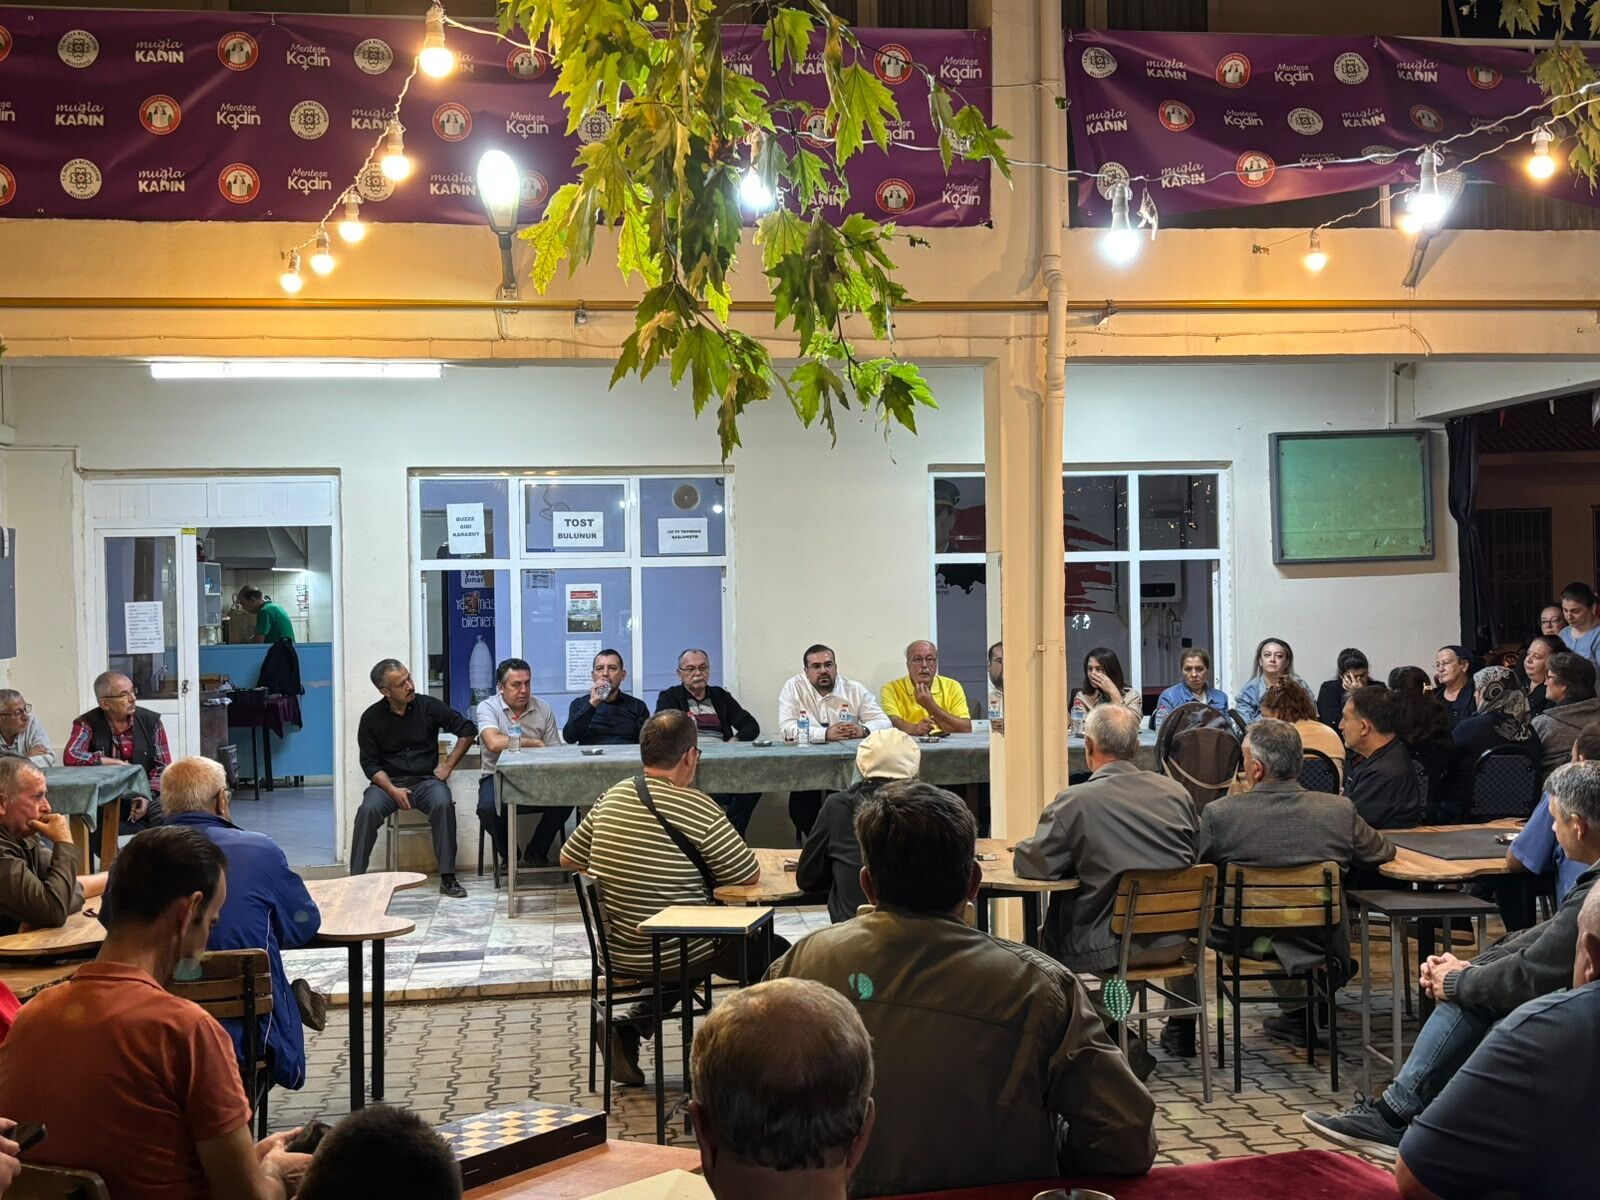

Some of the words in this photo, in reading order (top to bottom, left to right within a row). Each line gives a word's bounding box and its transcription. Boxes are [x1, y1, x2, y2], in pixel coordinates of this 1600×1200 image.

[135, 50, 184, 63] KADIN
[795, 62, 825, 75] KAD
[1146, 68, 1187, 81] KADIN
[1397, 70, 1438, 82] KADIN
[55, 113, 104, 126] KADIN
[1342, 113, 1386, 128] KADIN
[1086, 119, 1128, 136] KADIN
[138, 179, 185, 192] KADIN
[429, 182, 477, 196] KADIN
[564, 518, 594, 527] TOST
